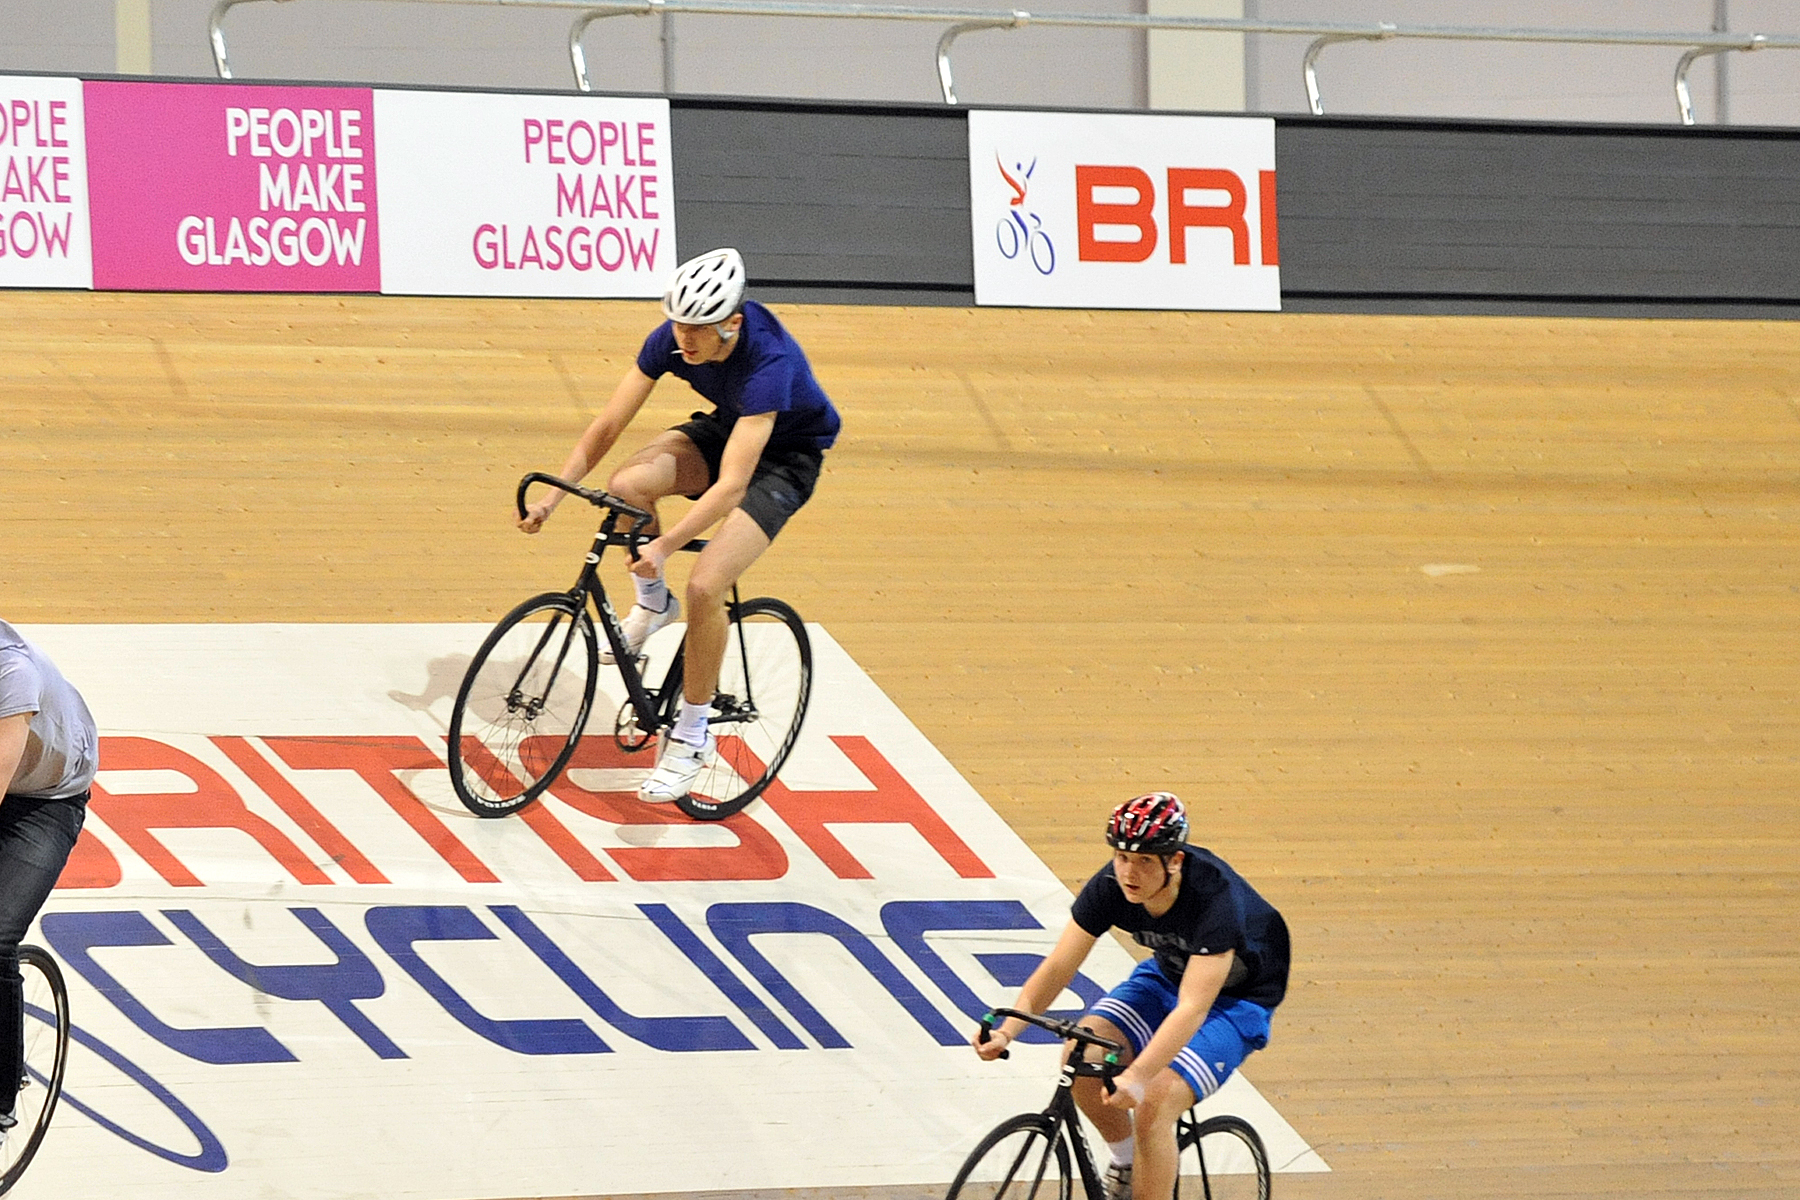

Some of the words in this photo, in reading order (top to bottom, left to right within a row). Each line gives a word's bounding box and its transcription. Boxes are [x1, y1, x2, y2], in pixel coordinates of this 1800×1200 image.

[226, 107, 363, 158] PEOPLE
[523, 118, 657, 167] PEOPLE
[260, 163, 365, 212] MAKE
[557, 172, 659, 219] MAKE
[1075, 164, 1280, 266] BRI
[177, 216, 367, 266] GLASGOW
[473, 223, 659, 272] GLASGOW
[40, 899, 1110, 1065] CYCLING
